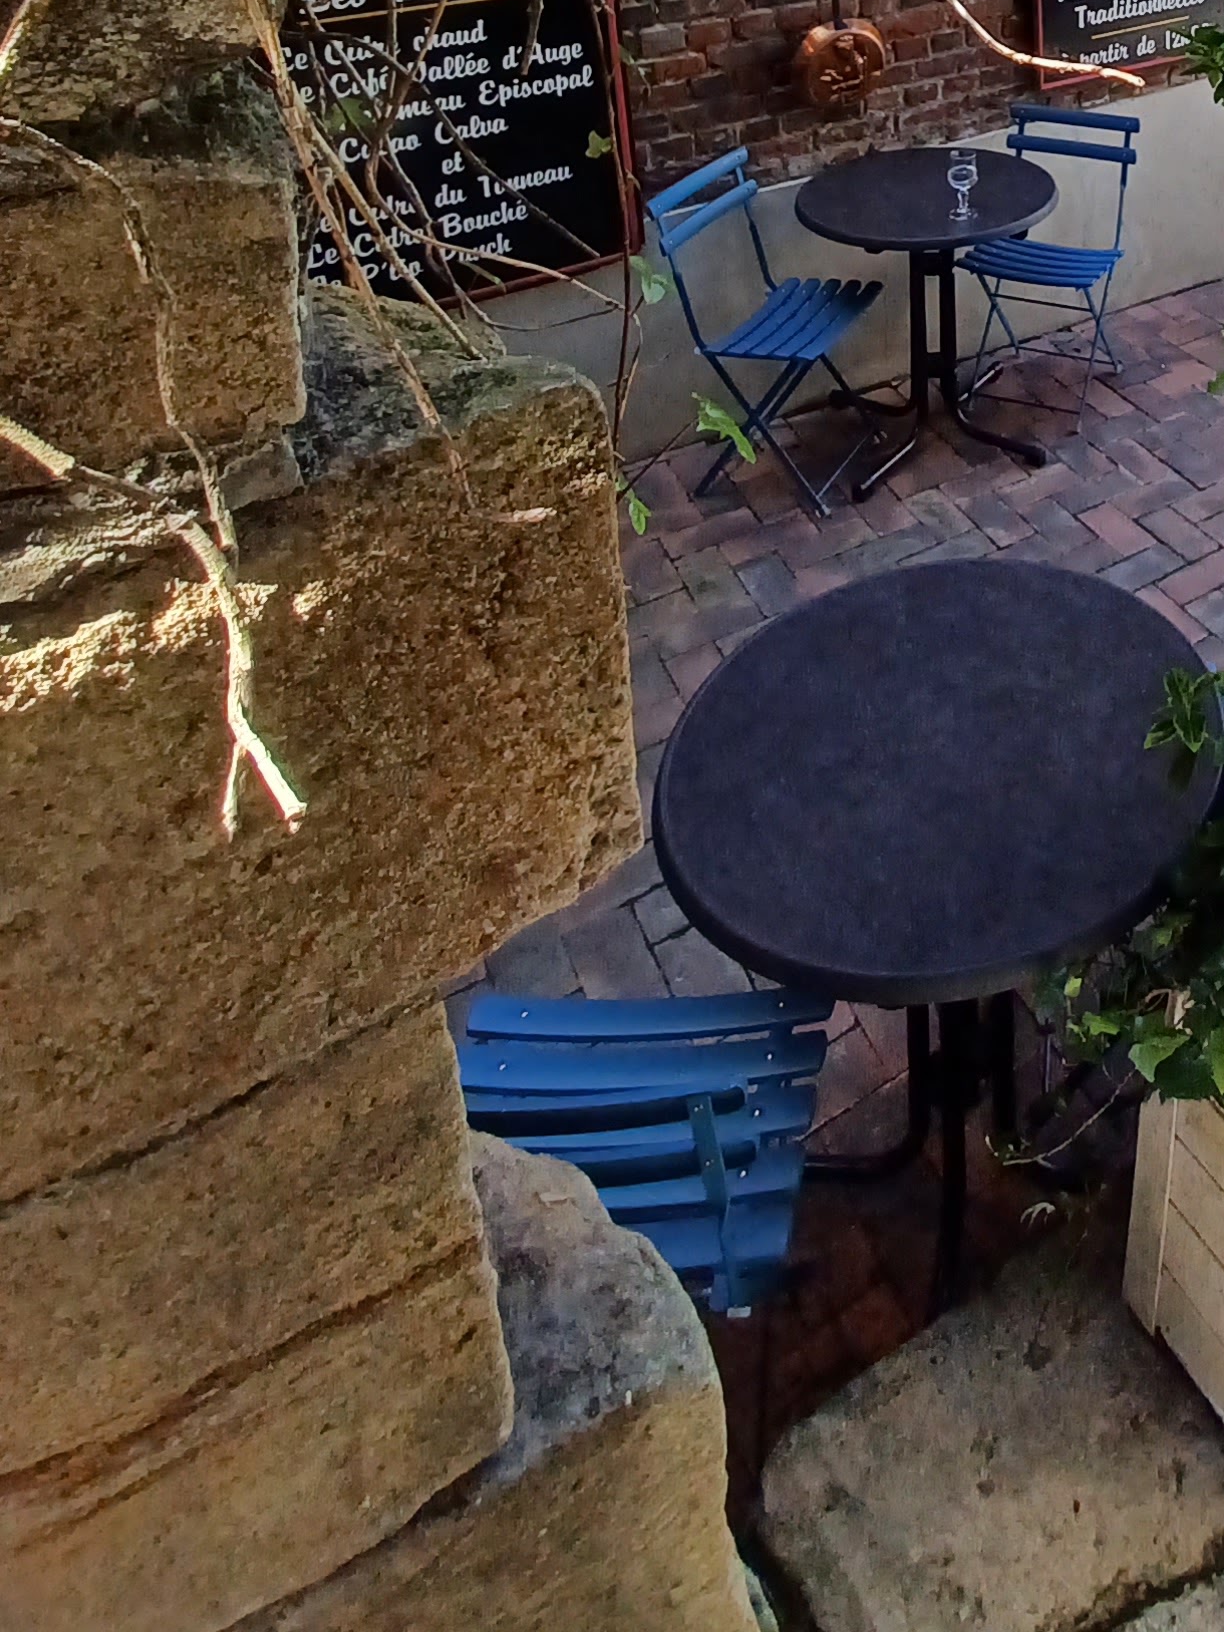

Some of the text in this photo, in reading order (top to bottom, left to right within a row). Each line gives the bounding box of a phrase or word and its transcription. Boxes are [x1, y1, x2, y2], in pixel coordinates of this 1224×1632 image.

[412, 18, 488, 52] chaud
[1136, 34, 1157, 57] de
[406, 52, 491, 83] Vallée
[502, 42, 584, 70] d'Auge
[478, 64, 595, 107] Episcopal
[339, 115, 509, 163] Caao Calva
[441, 151, 465, 175] et
[434, 183, 467, 208] du
[307, 243, 340, 268] Le
[438, 199, 529, 238] Bouché
